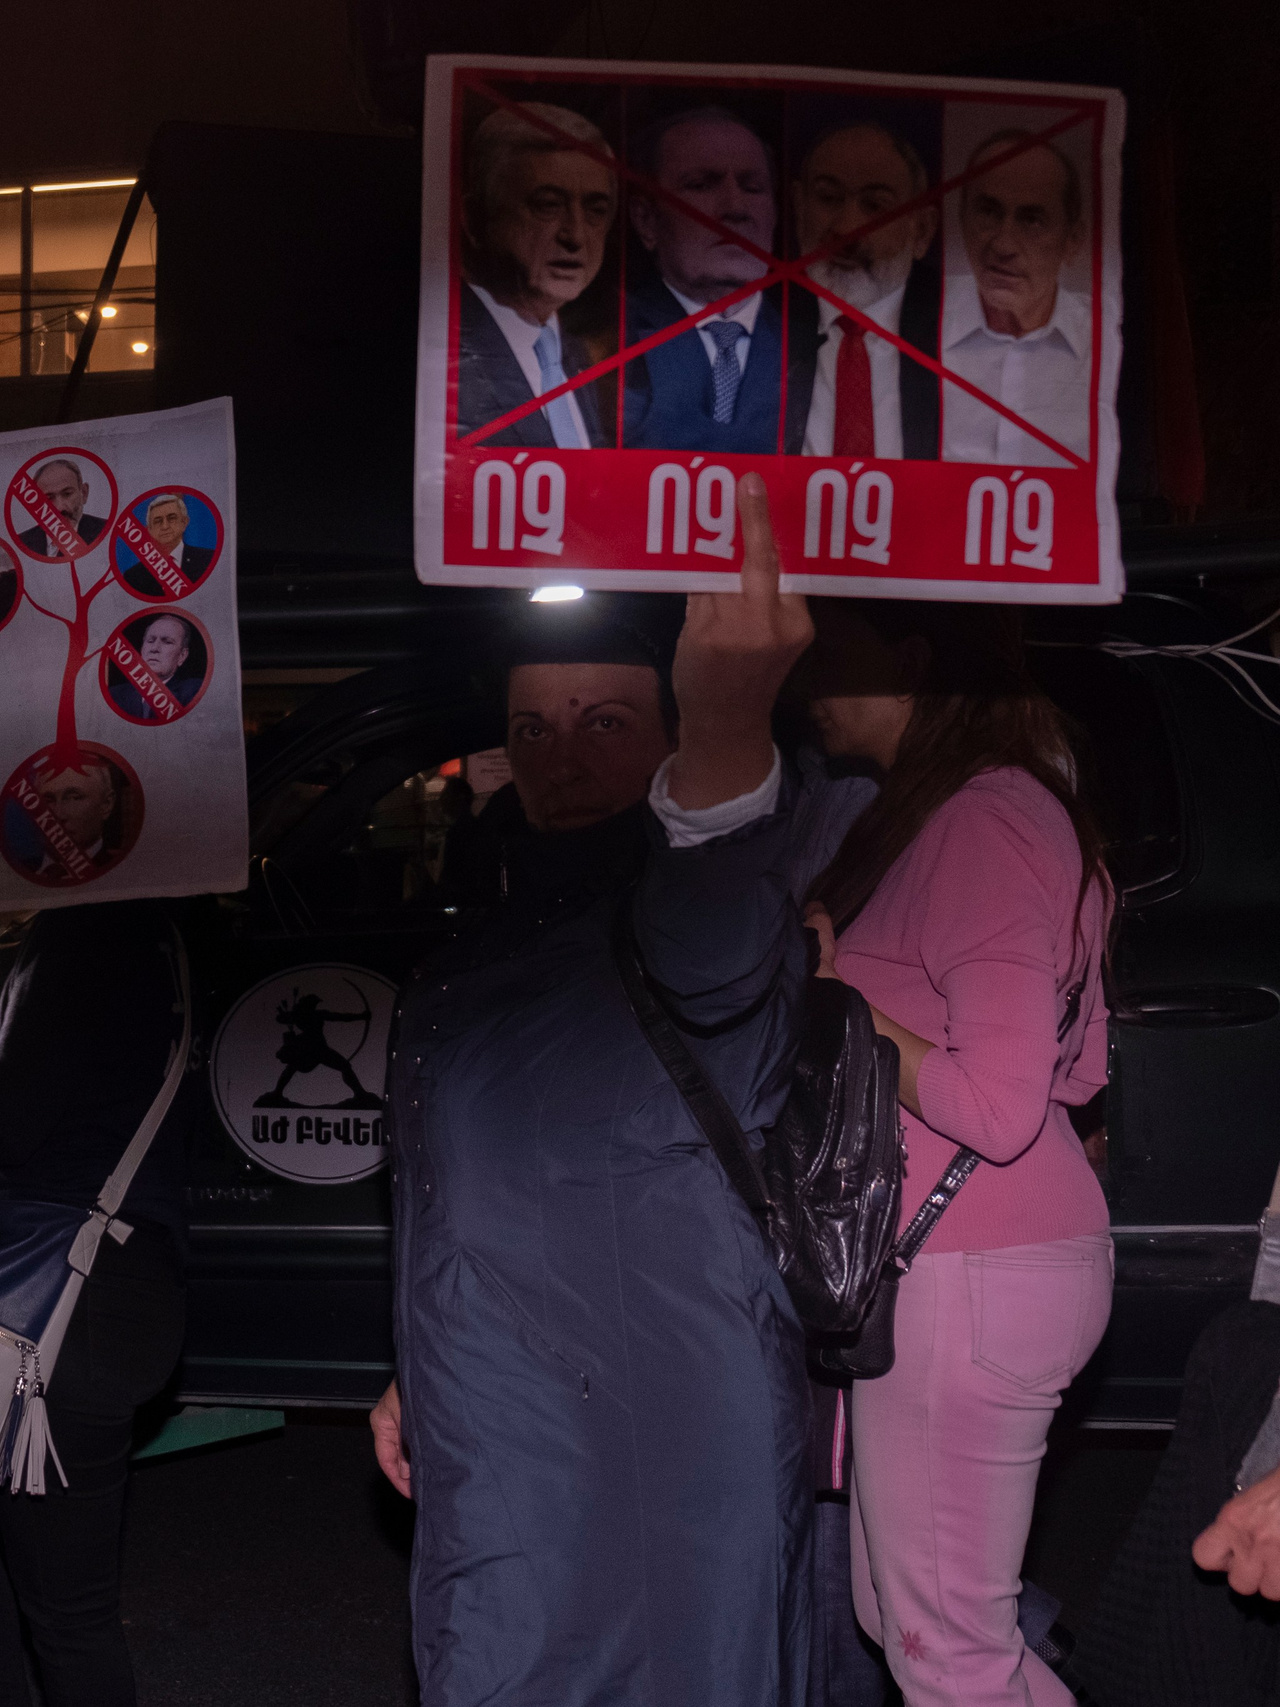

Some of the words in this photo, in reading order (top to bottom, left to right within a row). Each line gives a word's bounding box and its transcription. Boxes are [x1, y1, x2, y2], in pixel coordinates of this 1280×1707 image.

[12, 475, 40, 506] NO
[34, 502, 79, 558] NIKOL
[117, 515, 144, 546] NO
[137, 541, 188, 598] SERJIK
[107, 637, 135, 667] NO
[128, 663, 180, 721] LEVON
[10, 778, 40, 810] NO
[35, 809, 90, 880] KREML
[252, 1115, 289, 1143] ԱԺ
